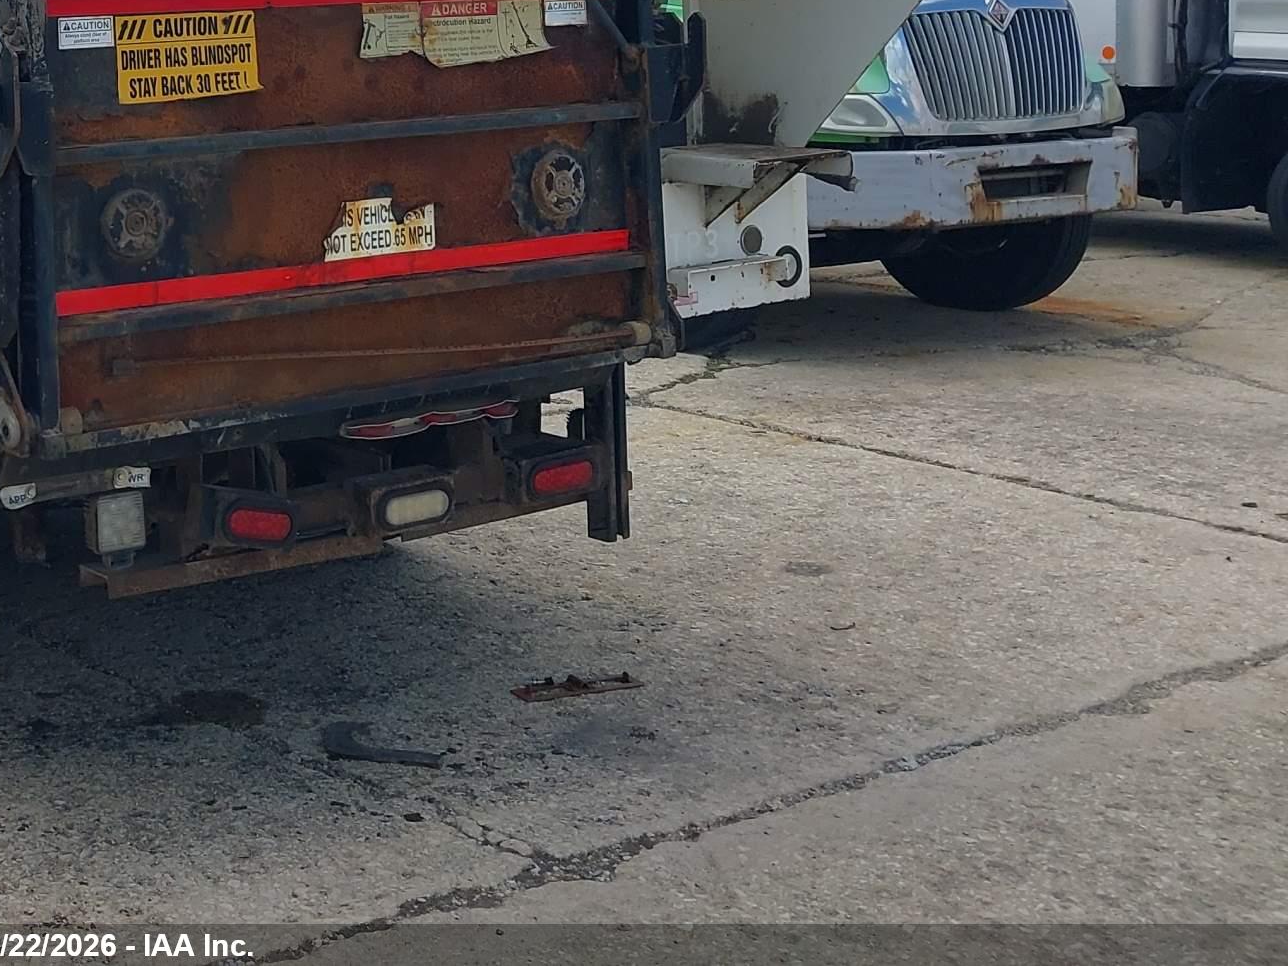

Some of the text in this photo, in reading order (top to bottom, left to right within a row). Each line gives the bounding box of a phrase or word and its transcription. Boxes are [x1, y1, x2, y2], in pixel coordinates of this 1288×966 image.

[442, 2, 487, 15] DANGER
[553, 2, 583, 10] CAUTION
[71, 21, 109, 30] CAUTION
[153, 17, 218, 38] CAUTION
[121, 43, 251, 70] DRIVER HAS BLINDSPOT
[130, 77, 157, 98] STAY
[161, 75, 193, 96] BACK
[197, 74, 211, 93] 30
[214, 72, 241, 91] FEET
[357, 204, 394, 226] VEHICL
[326, 225, 432, 255] NOT EXCEED 65 MPH
